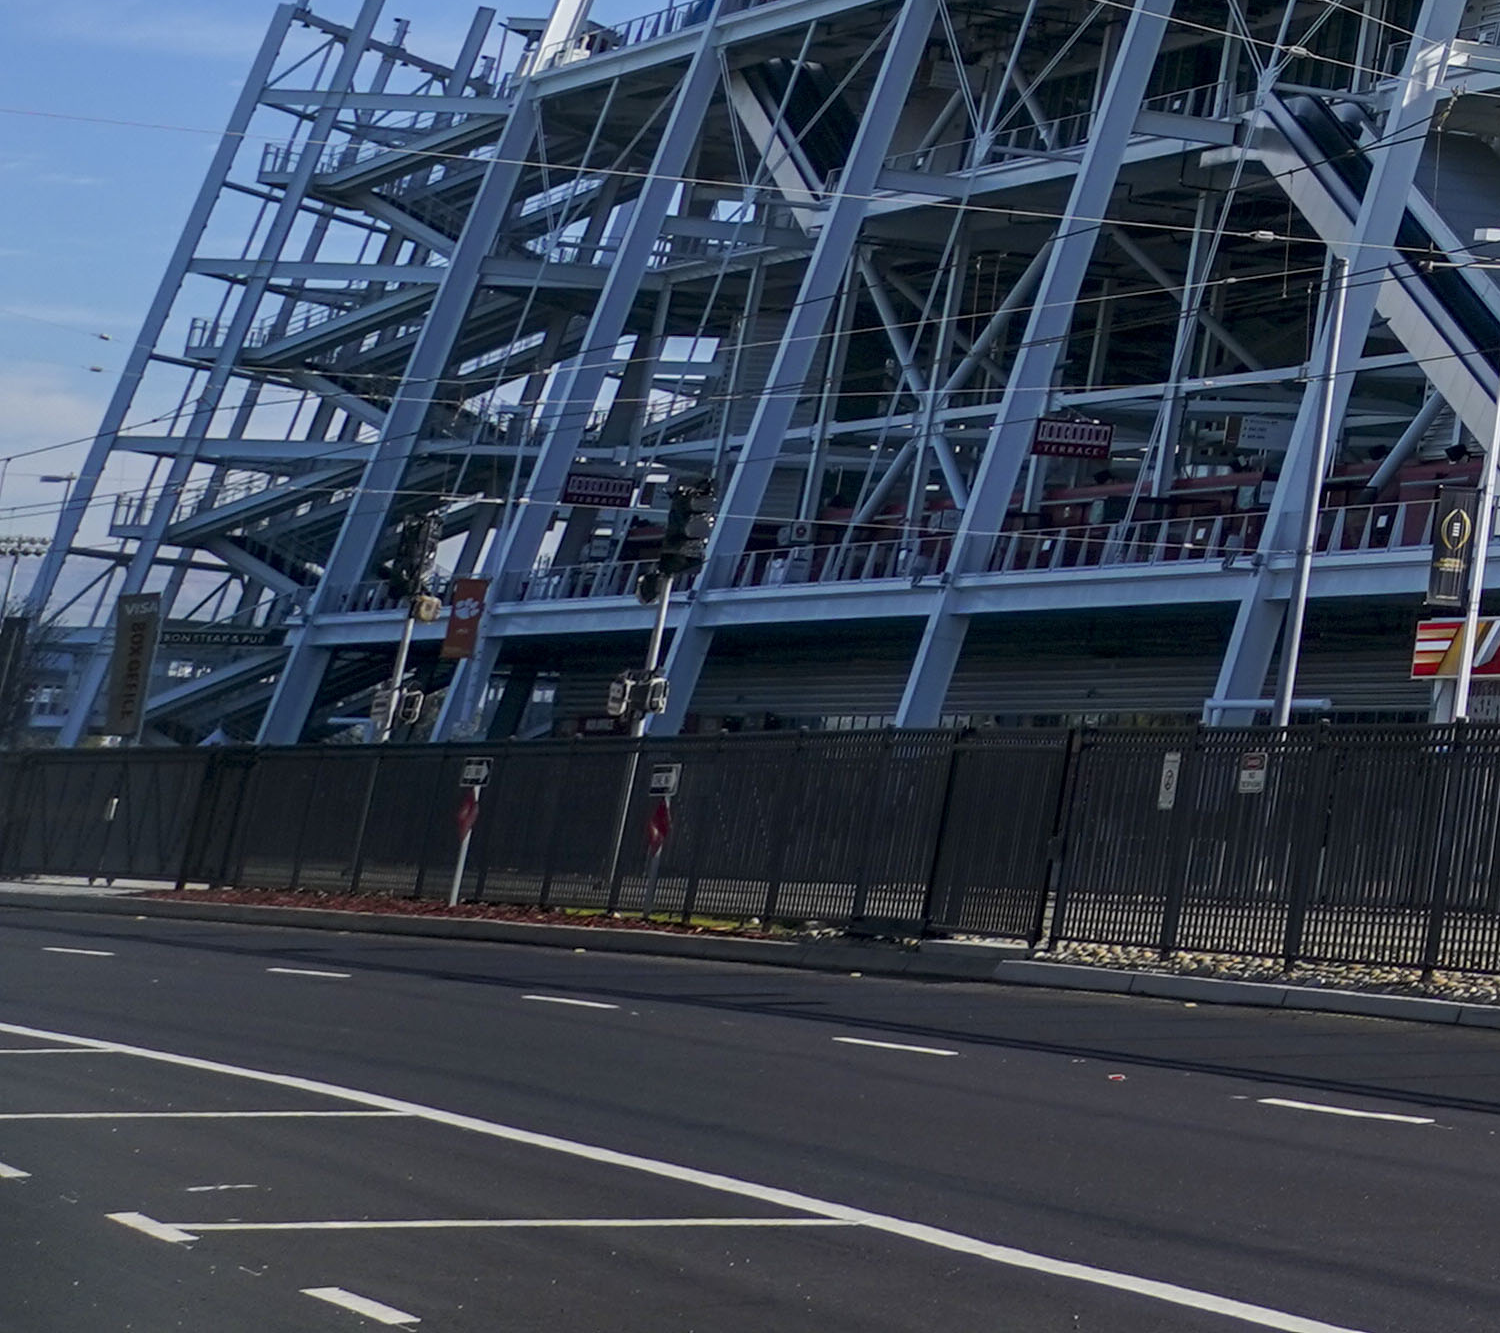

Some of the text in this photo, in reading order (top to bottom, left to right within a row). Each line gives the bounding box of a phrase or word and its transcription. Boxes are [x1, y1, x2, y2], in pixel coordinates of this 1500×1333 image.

[1044, 444, 1100, 456] TERRACE
[124, 602, 158, 616] VISA
[193, 634, 229, 644] STEAK
[121, 622, 147, 719] BOX OFFICE
